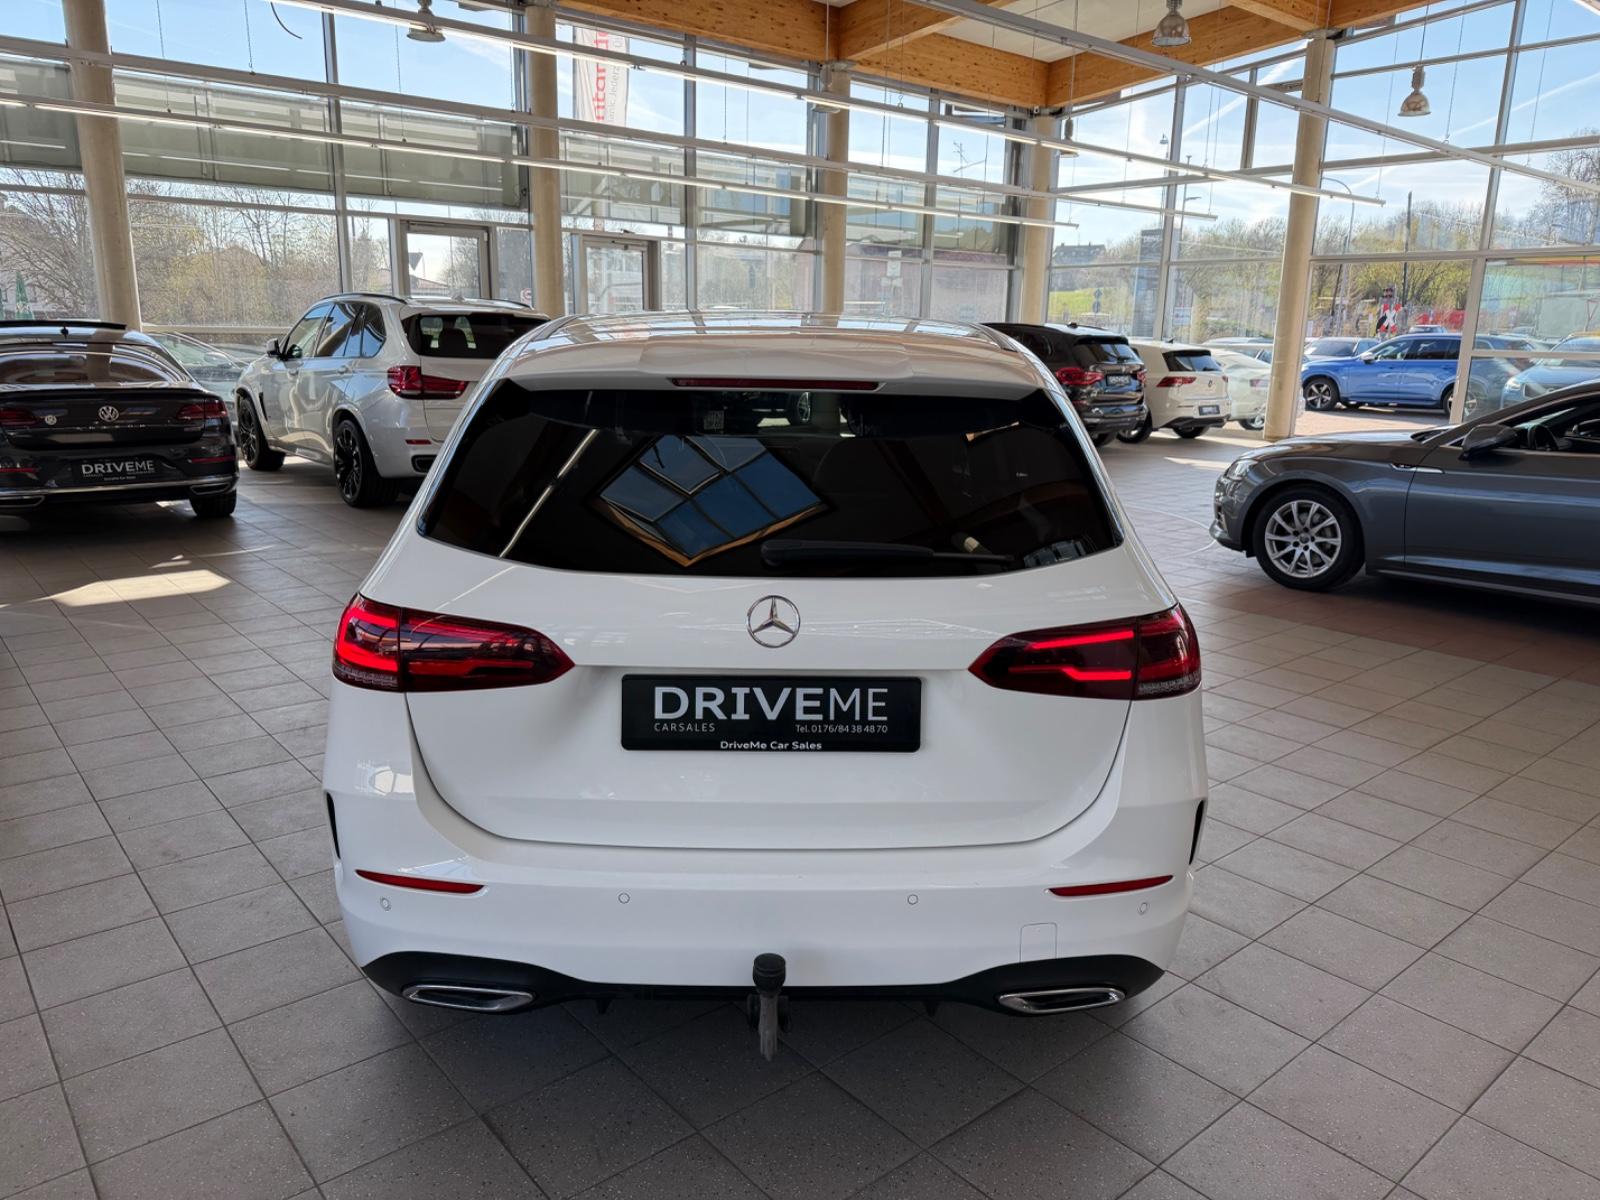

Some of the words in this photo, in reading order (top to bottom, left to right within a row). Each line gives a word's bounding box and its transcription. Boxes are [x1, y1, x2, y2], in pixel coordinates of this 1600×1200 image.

[81, 460, 154, 474] DRIVEME
[654, 687, 888, 721] DRIVEME
[654, 722, 716, 732] CARSALES
[720, 740, 767, 750] DriveMe
[770, 741, 789, 750] Car
[791, 741, 822, 750] Sales
